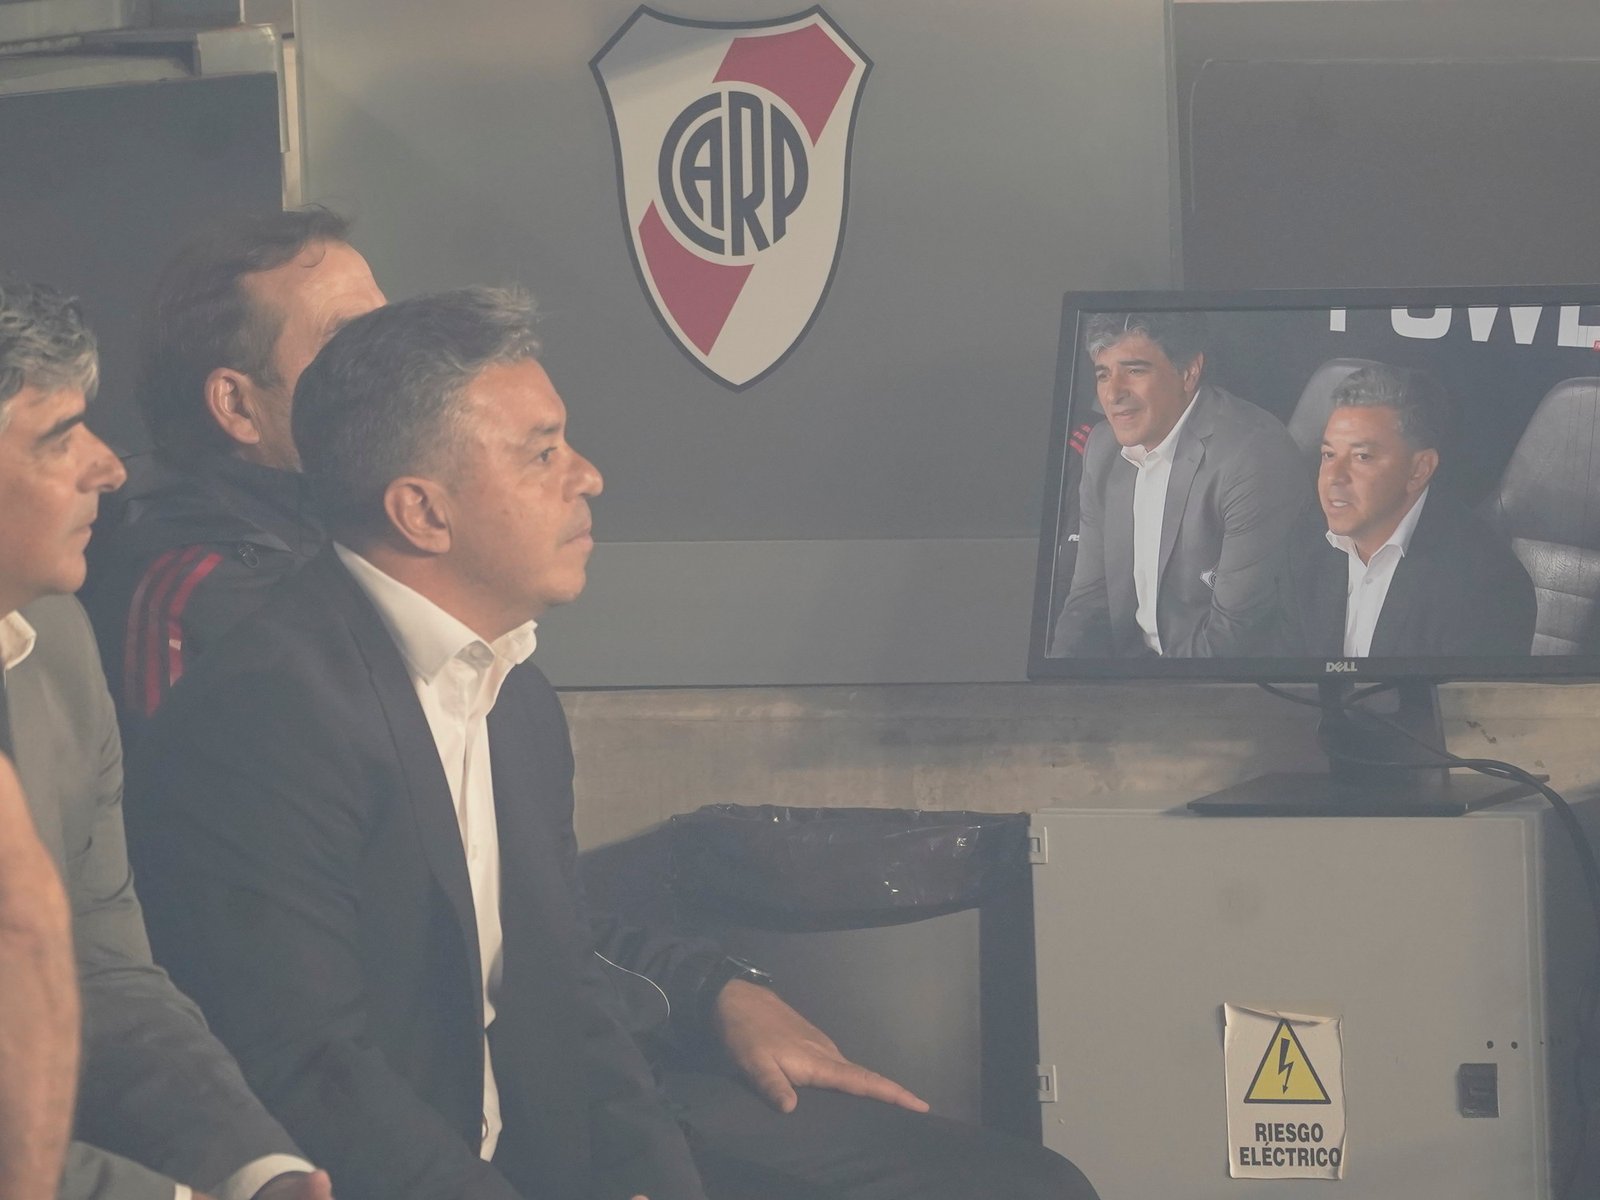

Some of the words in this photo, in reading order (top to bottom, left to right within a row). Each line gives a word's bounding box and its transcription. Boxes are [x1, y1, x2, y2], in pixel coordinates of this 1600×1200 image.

[658, 91, 809, 256] CARP
[1326, 661, 1357, 672] DELL
[1255, 1123, 1323, 1142] RIESGO
[1240, 1141, 1341, 1167] ELÉCTRICO
